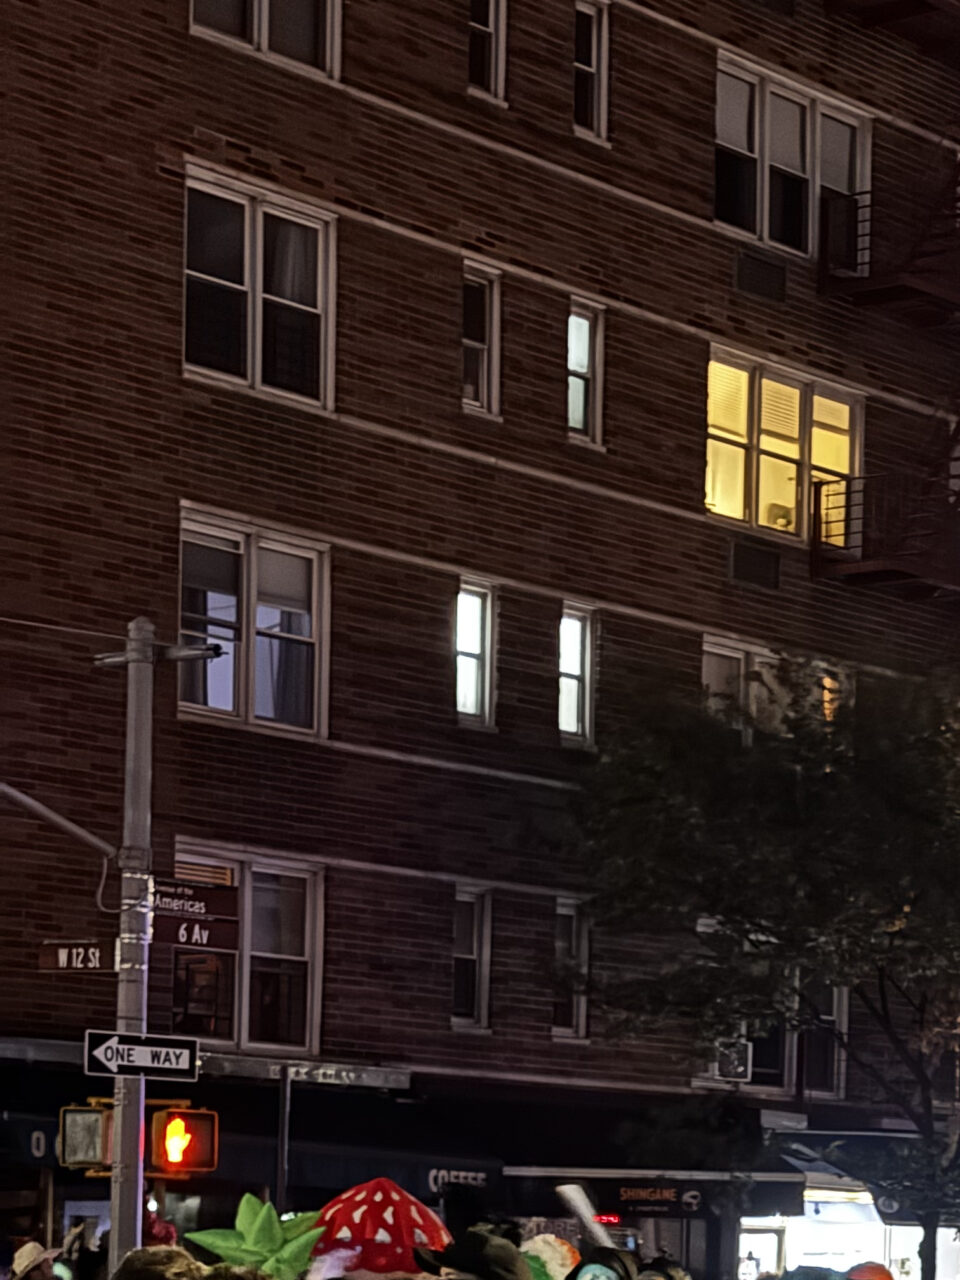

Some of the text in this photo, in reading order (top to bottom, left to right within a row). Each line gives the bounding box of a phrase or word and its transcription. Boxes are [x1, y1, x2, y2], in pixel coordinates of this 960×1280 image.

[155, 893, 206, 914] Americas
[178, 922, 209, 945] 6 Av
[58, 947, 100, 968] W 12 St
[104, 1045, 184, 1066] ONE WAY
